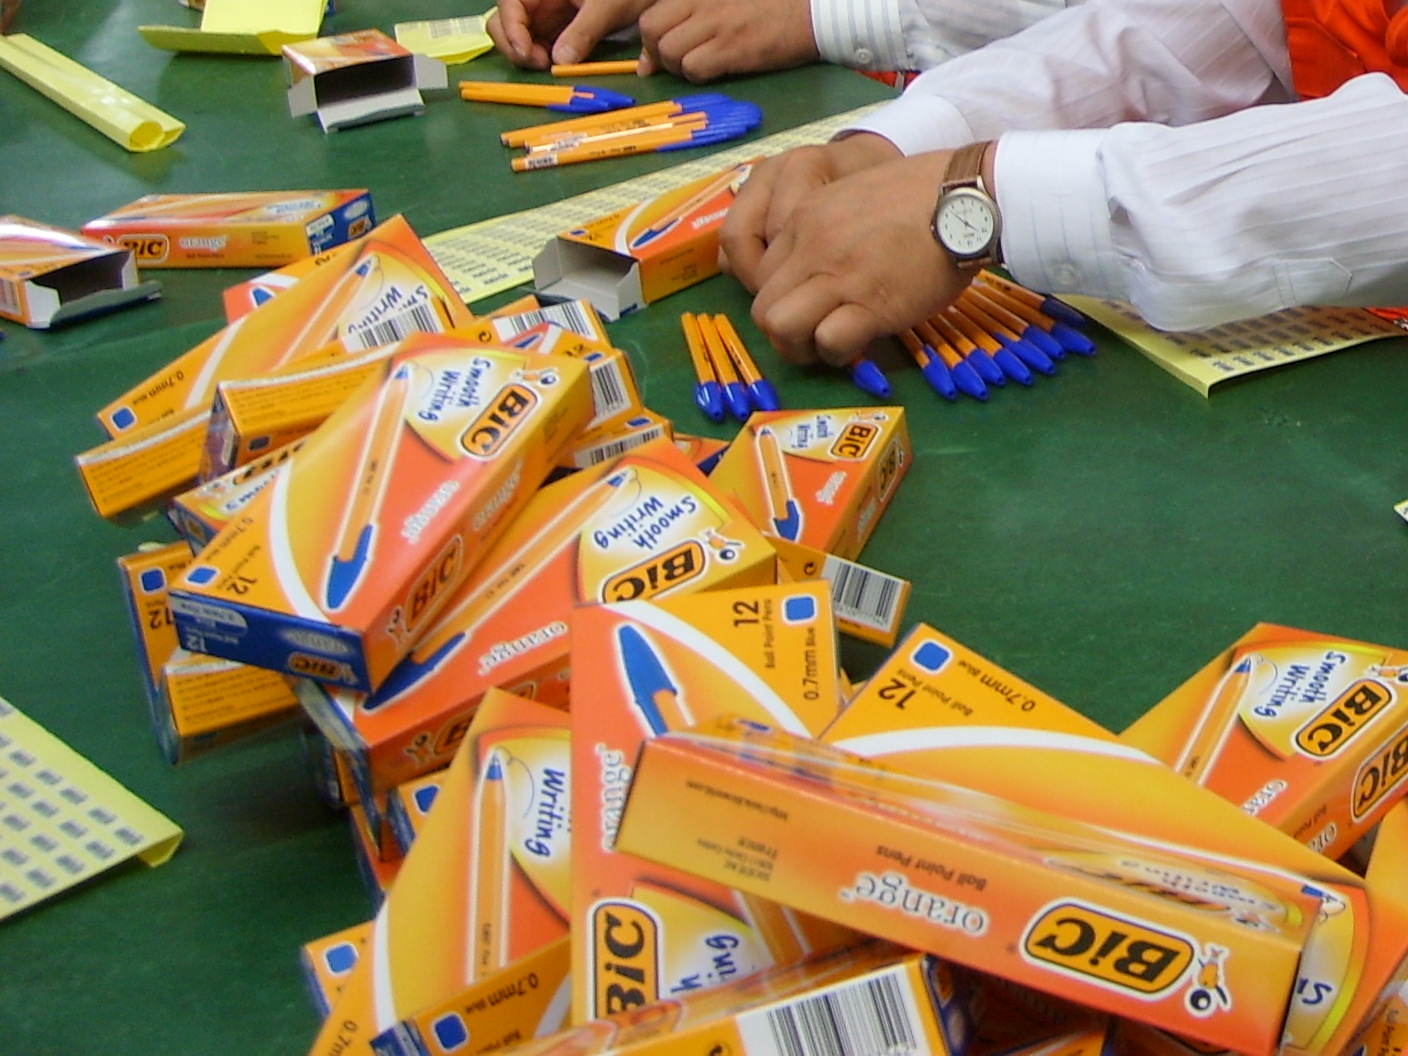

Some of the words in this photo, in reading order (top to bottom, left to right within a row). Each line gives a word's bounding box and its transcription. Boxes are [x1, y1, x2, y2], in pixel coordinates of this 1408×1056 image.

[418, 370, 460, 421] Writing
[457, 357, 491, 407] Smooth
[593, 496, 664, 550] Writing
[633, 496, 697, 550] Smooth
[734, 600, 759, 628] 12
[803, 648, 819, 701] 0.7mm
[878, 678, 917, 710] 12
[980, 672, 1037, 712] 0.7mm
[1253, 664, 1310, 718] Writing
[1299, 651, 1347, 703] Smooth
[525, 767, 565, 857] Writing
[876, 845, 911, 867] Pens
[914, 858, 953, 881] Point
[953, 870, 988, 891] Ball
[855, 873, 986, 935] orange
[488, 972, 540, 1008] 0.7mm
